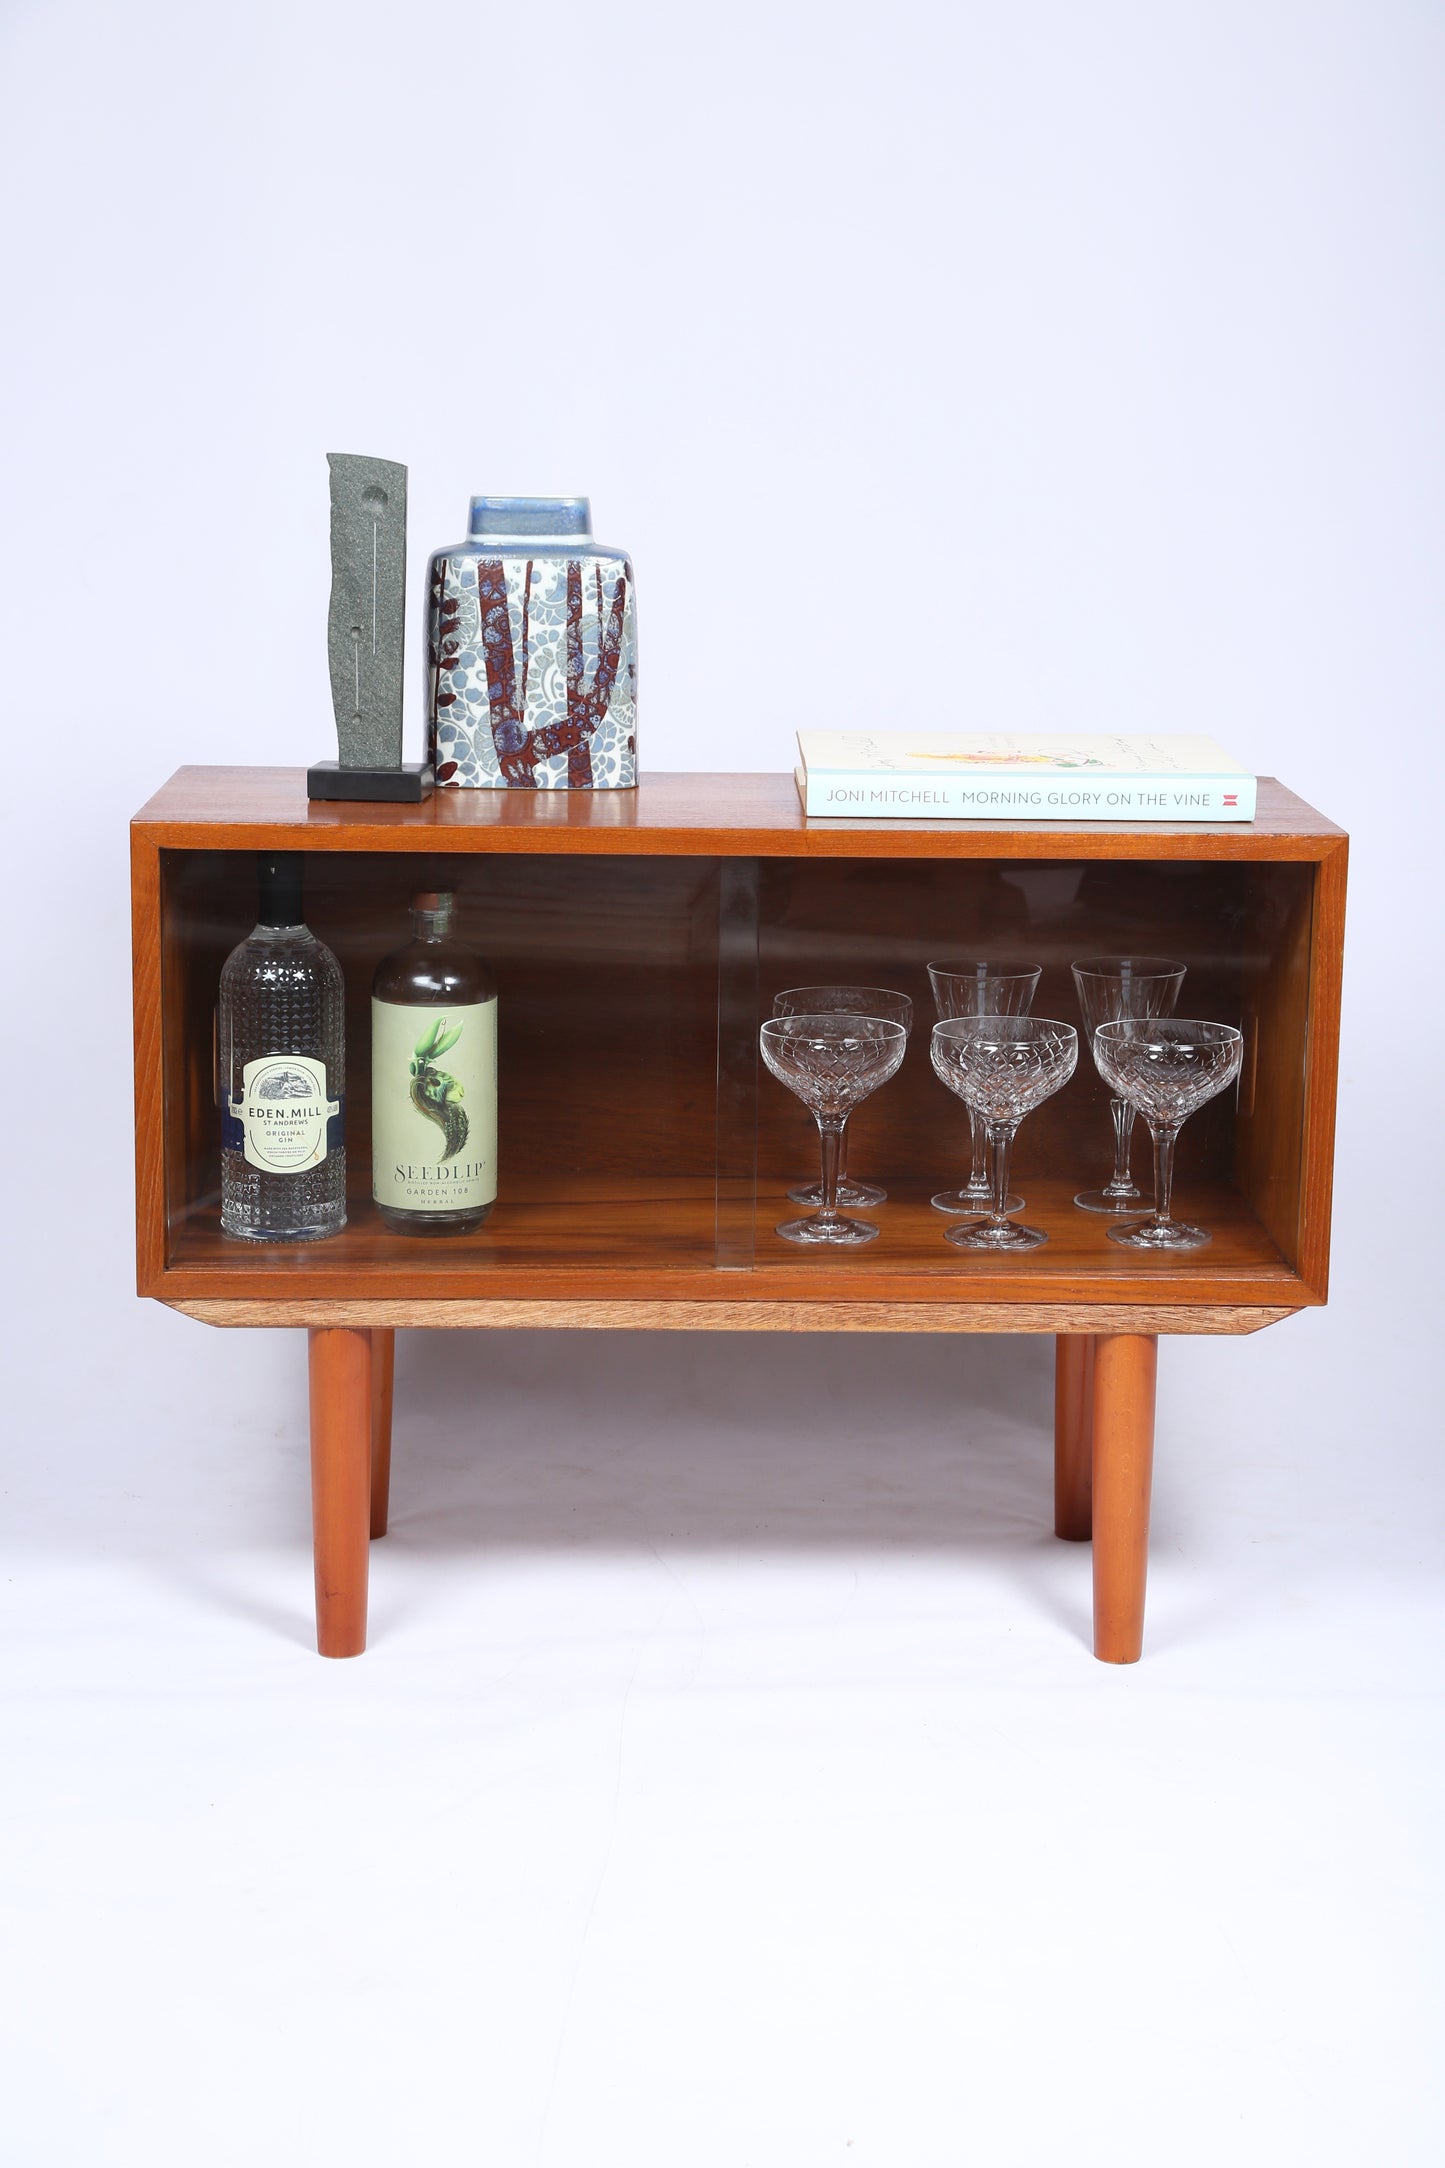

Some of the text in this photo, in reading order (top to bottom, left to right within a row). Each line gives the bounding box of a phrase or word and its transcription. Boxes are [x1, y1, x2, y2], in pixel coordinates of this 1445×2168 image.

[826, 789, 1211, 807] JONI MITCHELL MORNING GLORY ON THE VINE
[249, 1107, 321, 1119] EDEN.MILL
[394, 1162, 483, 1183] SEEDLIP
[406, 1187, 469, 1196] GARDEN 108
